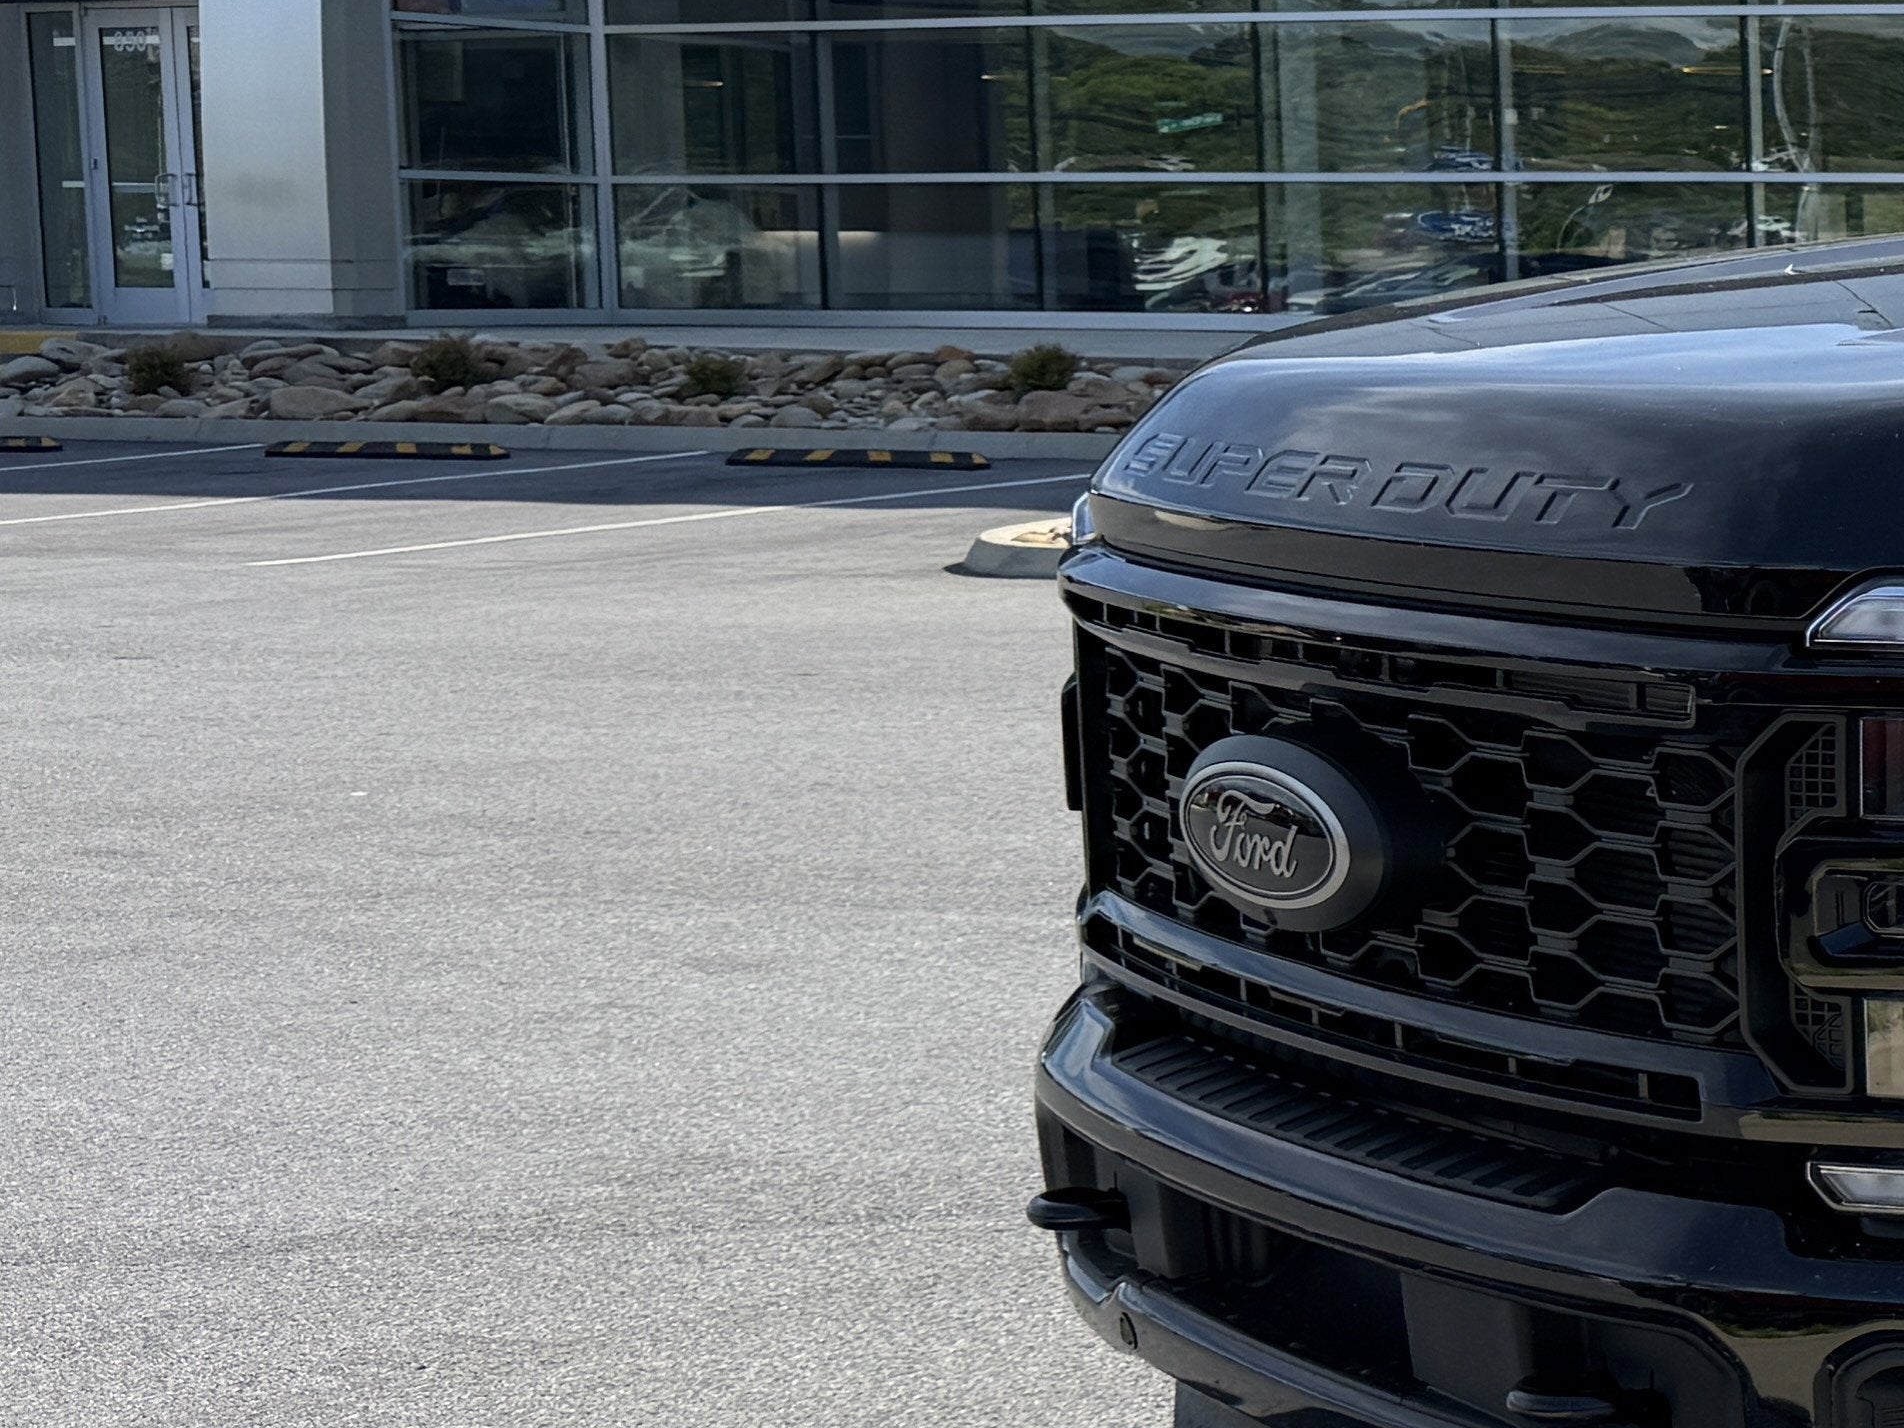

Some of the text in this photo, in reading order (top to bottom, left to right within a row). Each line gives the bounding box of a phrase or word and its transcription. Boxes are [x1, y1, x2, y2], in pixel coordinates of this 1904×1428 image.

[1126, 432, 1695, 530] SUPER DUTY
[1210, 789, 1298, 878] Ford
